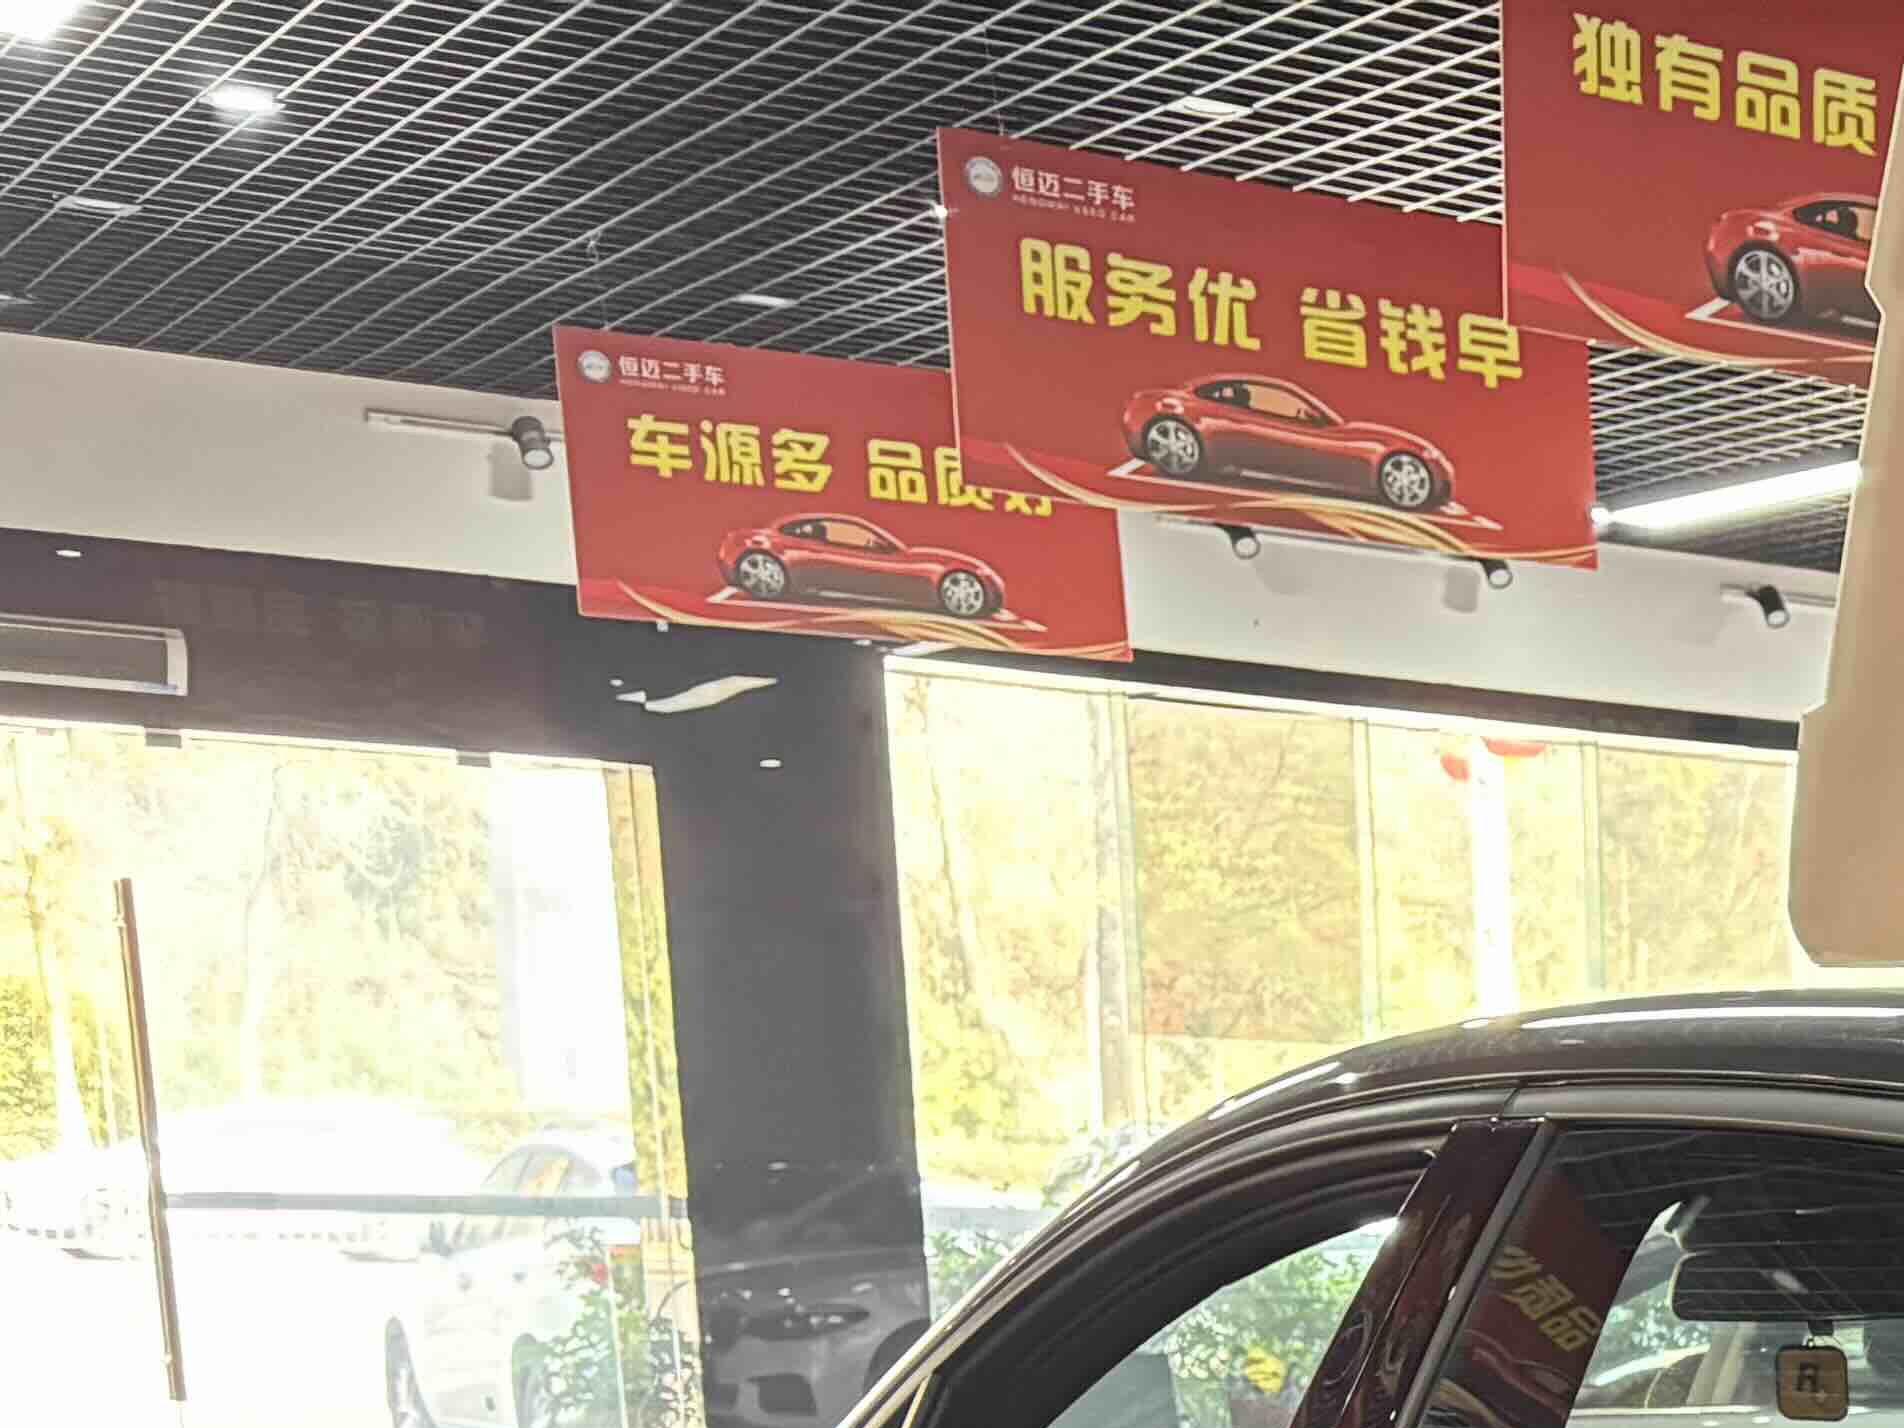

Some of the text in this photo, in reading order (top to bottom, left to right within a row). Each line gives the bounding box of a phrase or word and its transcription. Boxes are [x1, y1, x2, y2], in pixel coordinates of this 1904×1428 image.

[1572, 14, 1877, 156] 独有品质
[1012, 166, 1135, 210] 恒迈二手车
[1020, 238, 1522, 388] 服务优 省钱早
[619, 355, 724, 386] 恒迈二手车
[627, 414, 1052, 516] 车源多 品质
